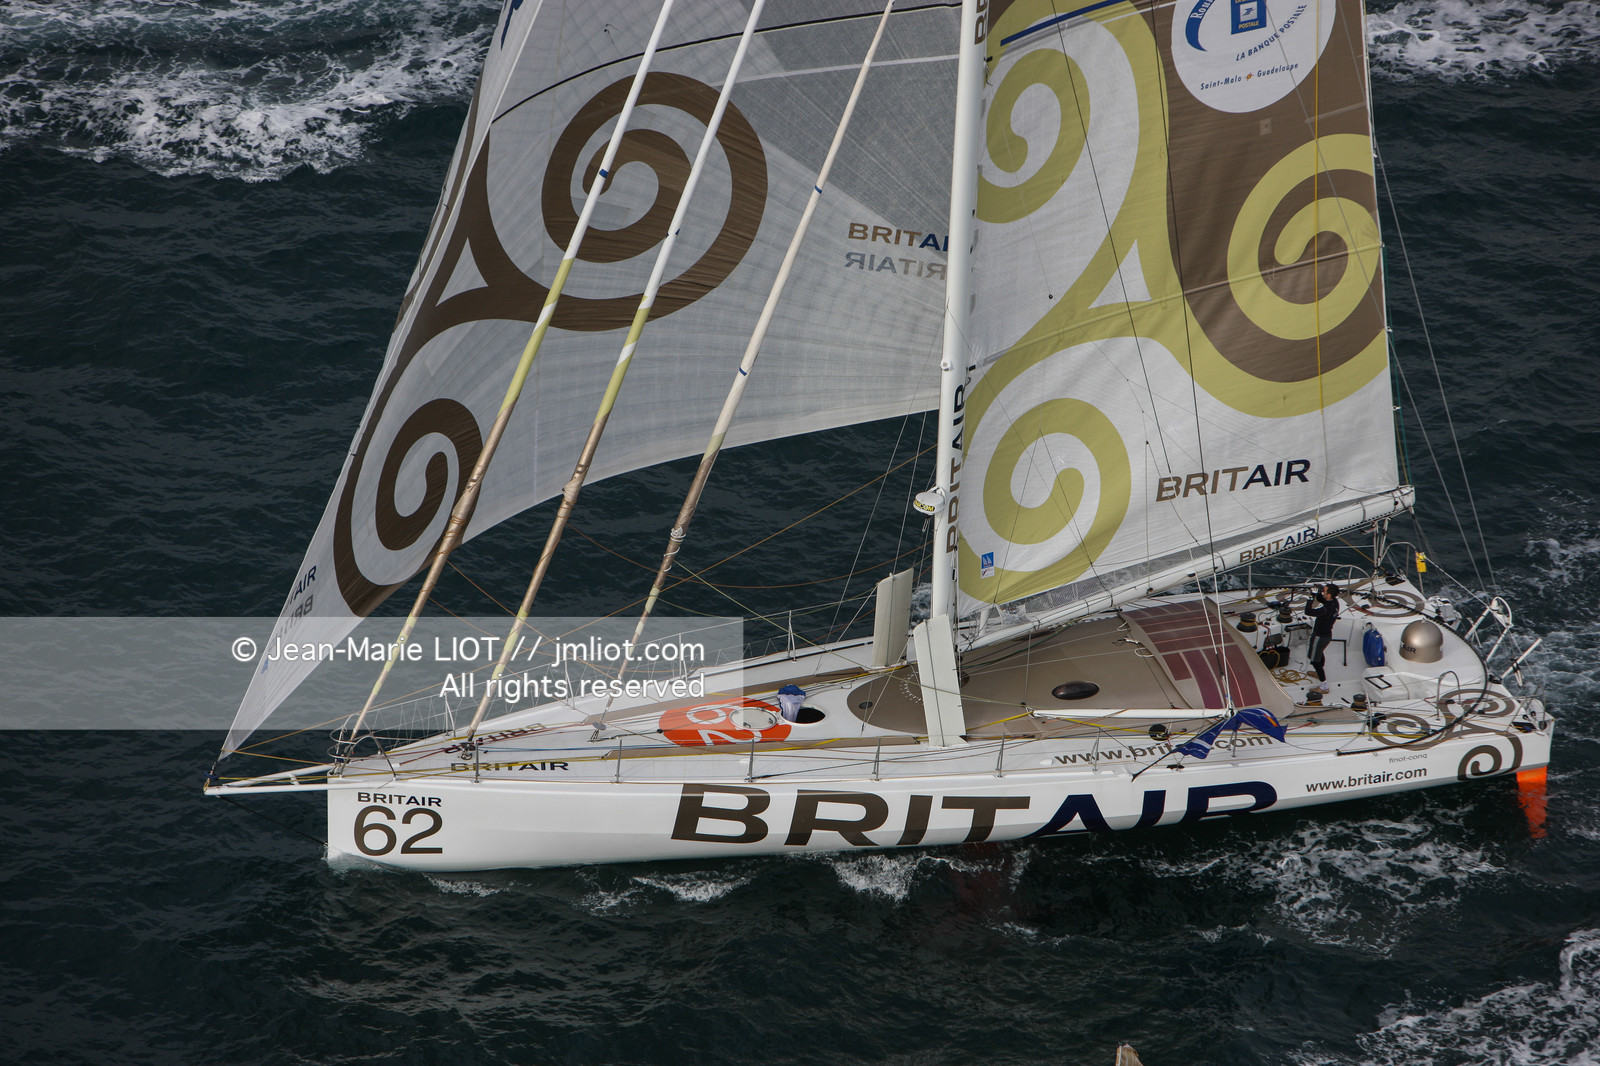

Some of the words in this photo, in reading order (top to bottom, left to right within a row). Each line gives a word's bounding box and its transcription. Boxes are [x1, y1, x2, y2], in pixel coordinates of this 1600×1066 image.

[1235, 52, 1246, 62] LA
[1248, 32, 1281, 57] BANQUE
[1279, 4, 1308, 33] POSTALE
[1238, 21, 1260, 29] POSTALE
[1200, 75, 1242, 91] Saint-Malo
[1257, 63, 1299, 78] Guadeloupe
[848, 222, 949, 252] BRITAI
[1156, 459, 1311, 502] BRITAIR
[1239, 527, 1317, 564] BRITAIR
[1055, 735, 1273, 765] www.brit.com
[450, 761, 569, 772] BRITAIR
[1306, 767, 1427, 793] www.britair.com
[357, 792, 442, 807] BRITAIR
[670, 780, 1278, 846] BRITAIR
[353, 805, 443, 856] 62
